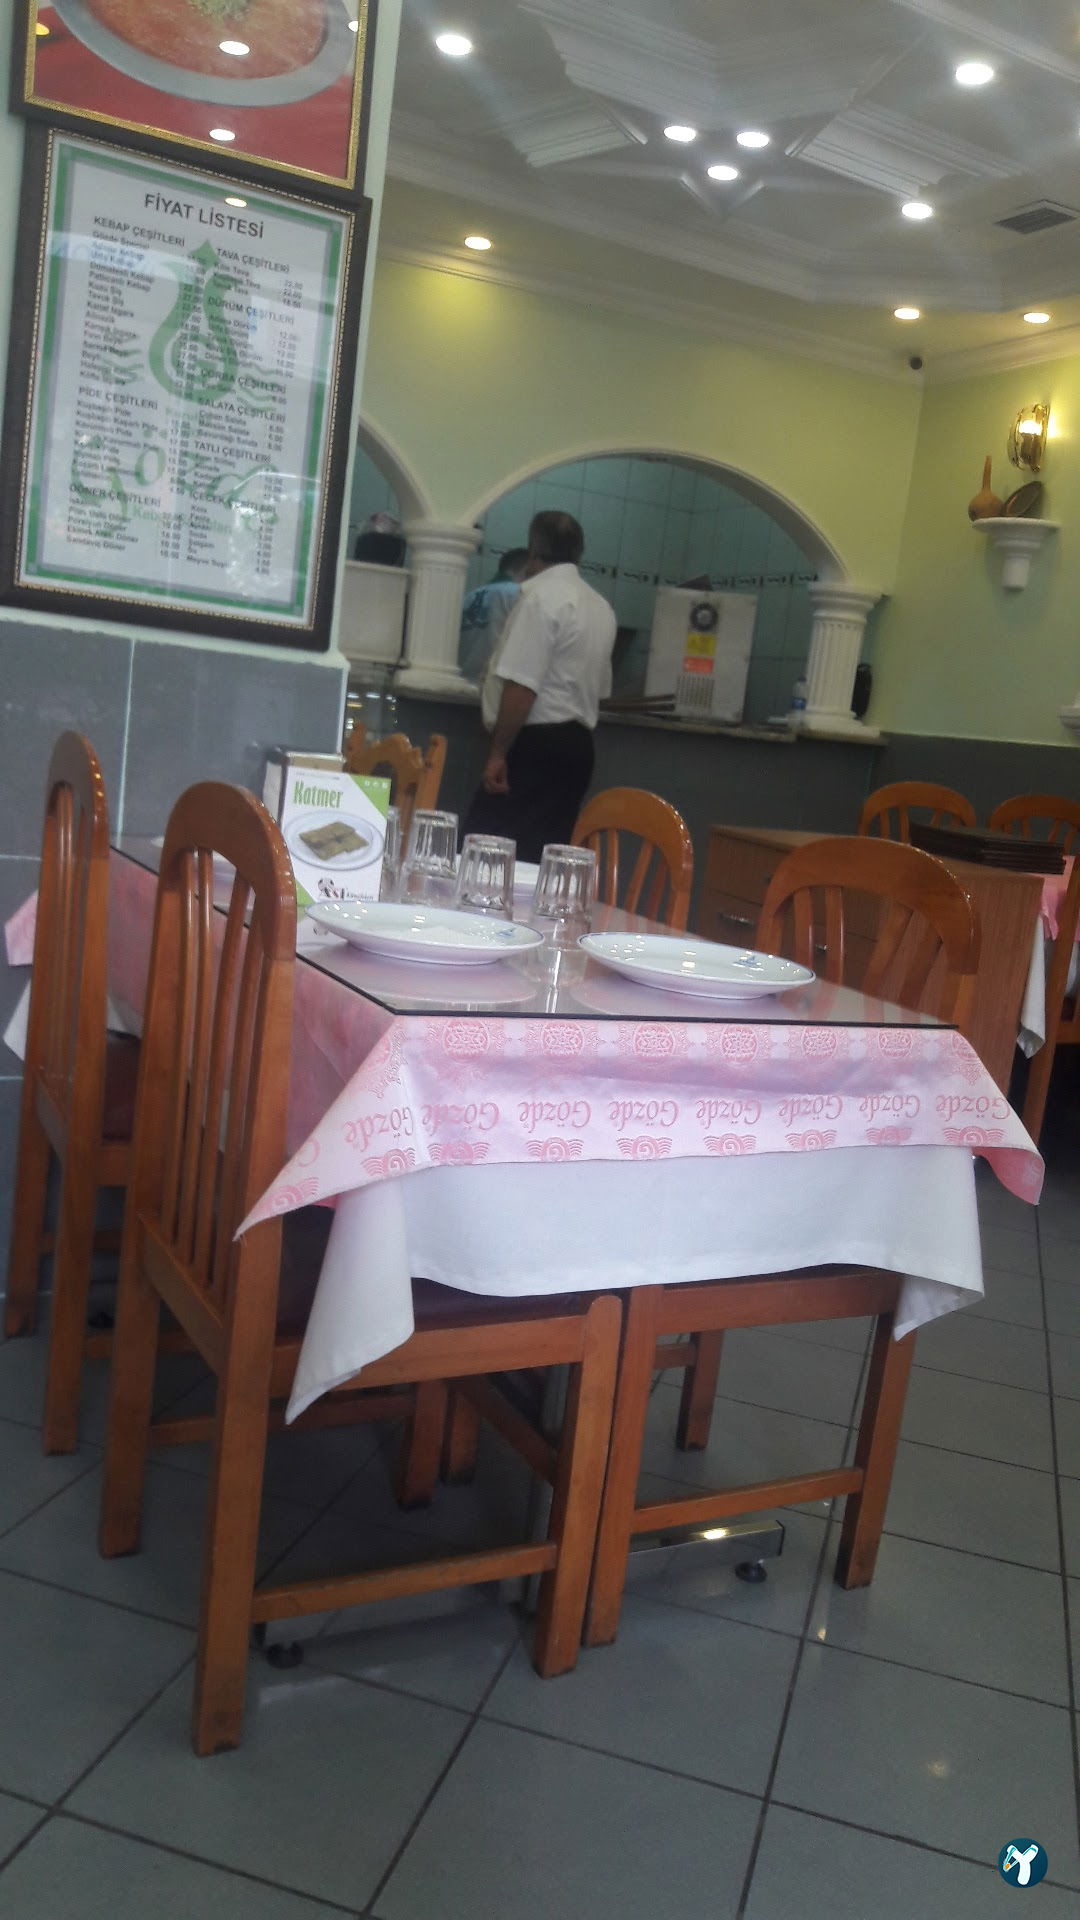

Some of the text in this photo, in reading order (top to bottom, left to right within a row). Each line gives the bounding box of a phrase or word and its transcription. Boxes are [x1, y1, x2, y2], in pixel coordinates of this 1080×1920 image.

[144, 192, 263, 239] FİYAT LİSTESİ
[94, 216, 185, 247] KEBAP ÇEŞİTLERİ
[217, 248, 290, 274] TAVA ÇEŞİTLERİ
[78, 386, 159, 411] PİDE ÇEŞİTLERİ
[194, 440, 220, 454] TATLI
[293, 778, 344, 809] Katmer
[344, 1094, 1010, 1151] Gözde Gözde Gözde Gözde Gözde Gözde Gözde Gözde
